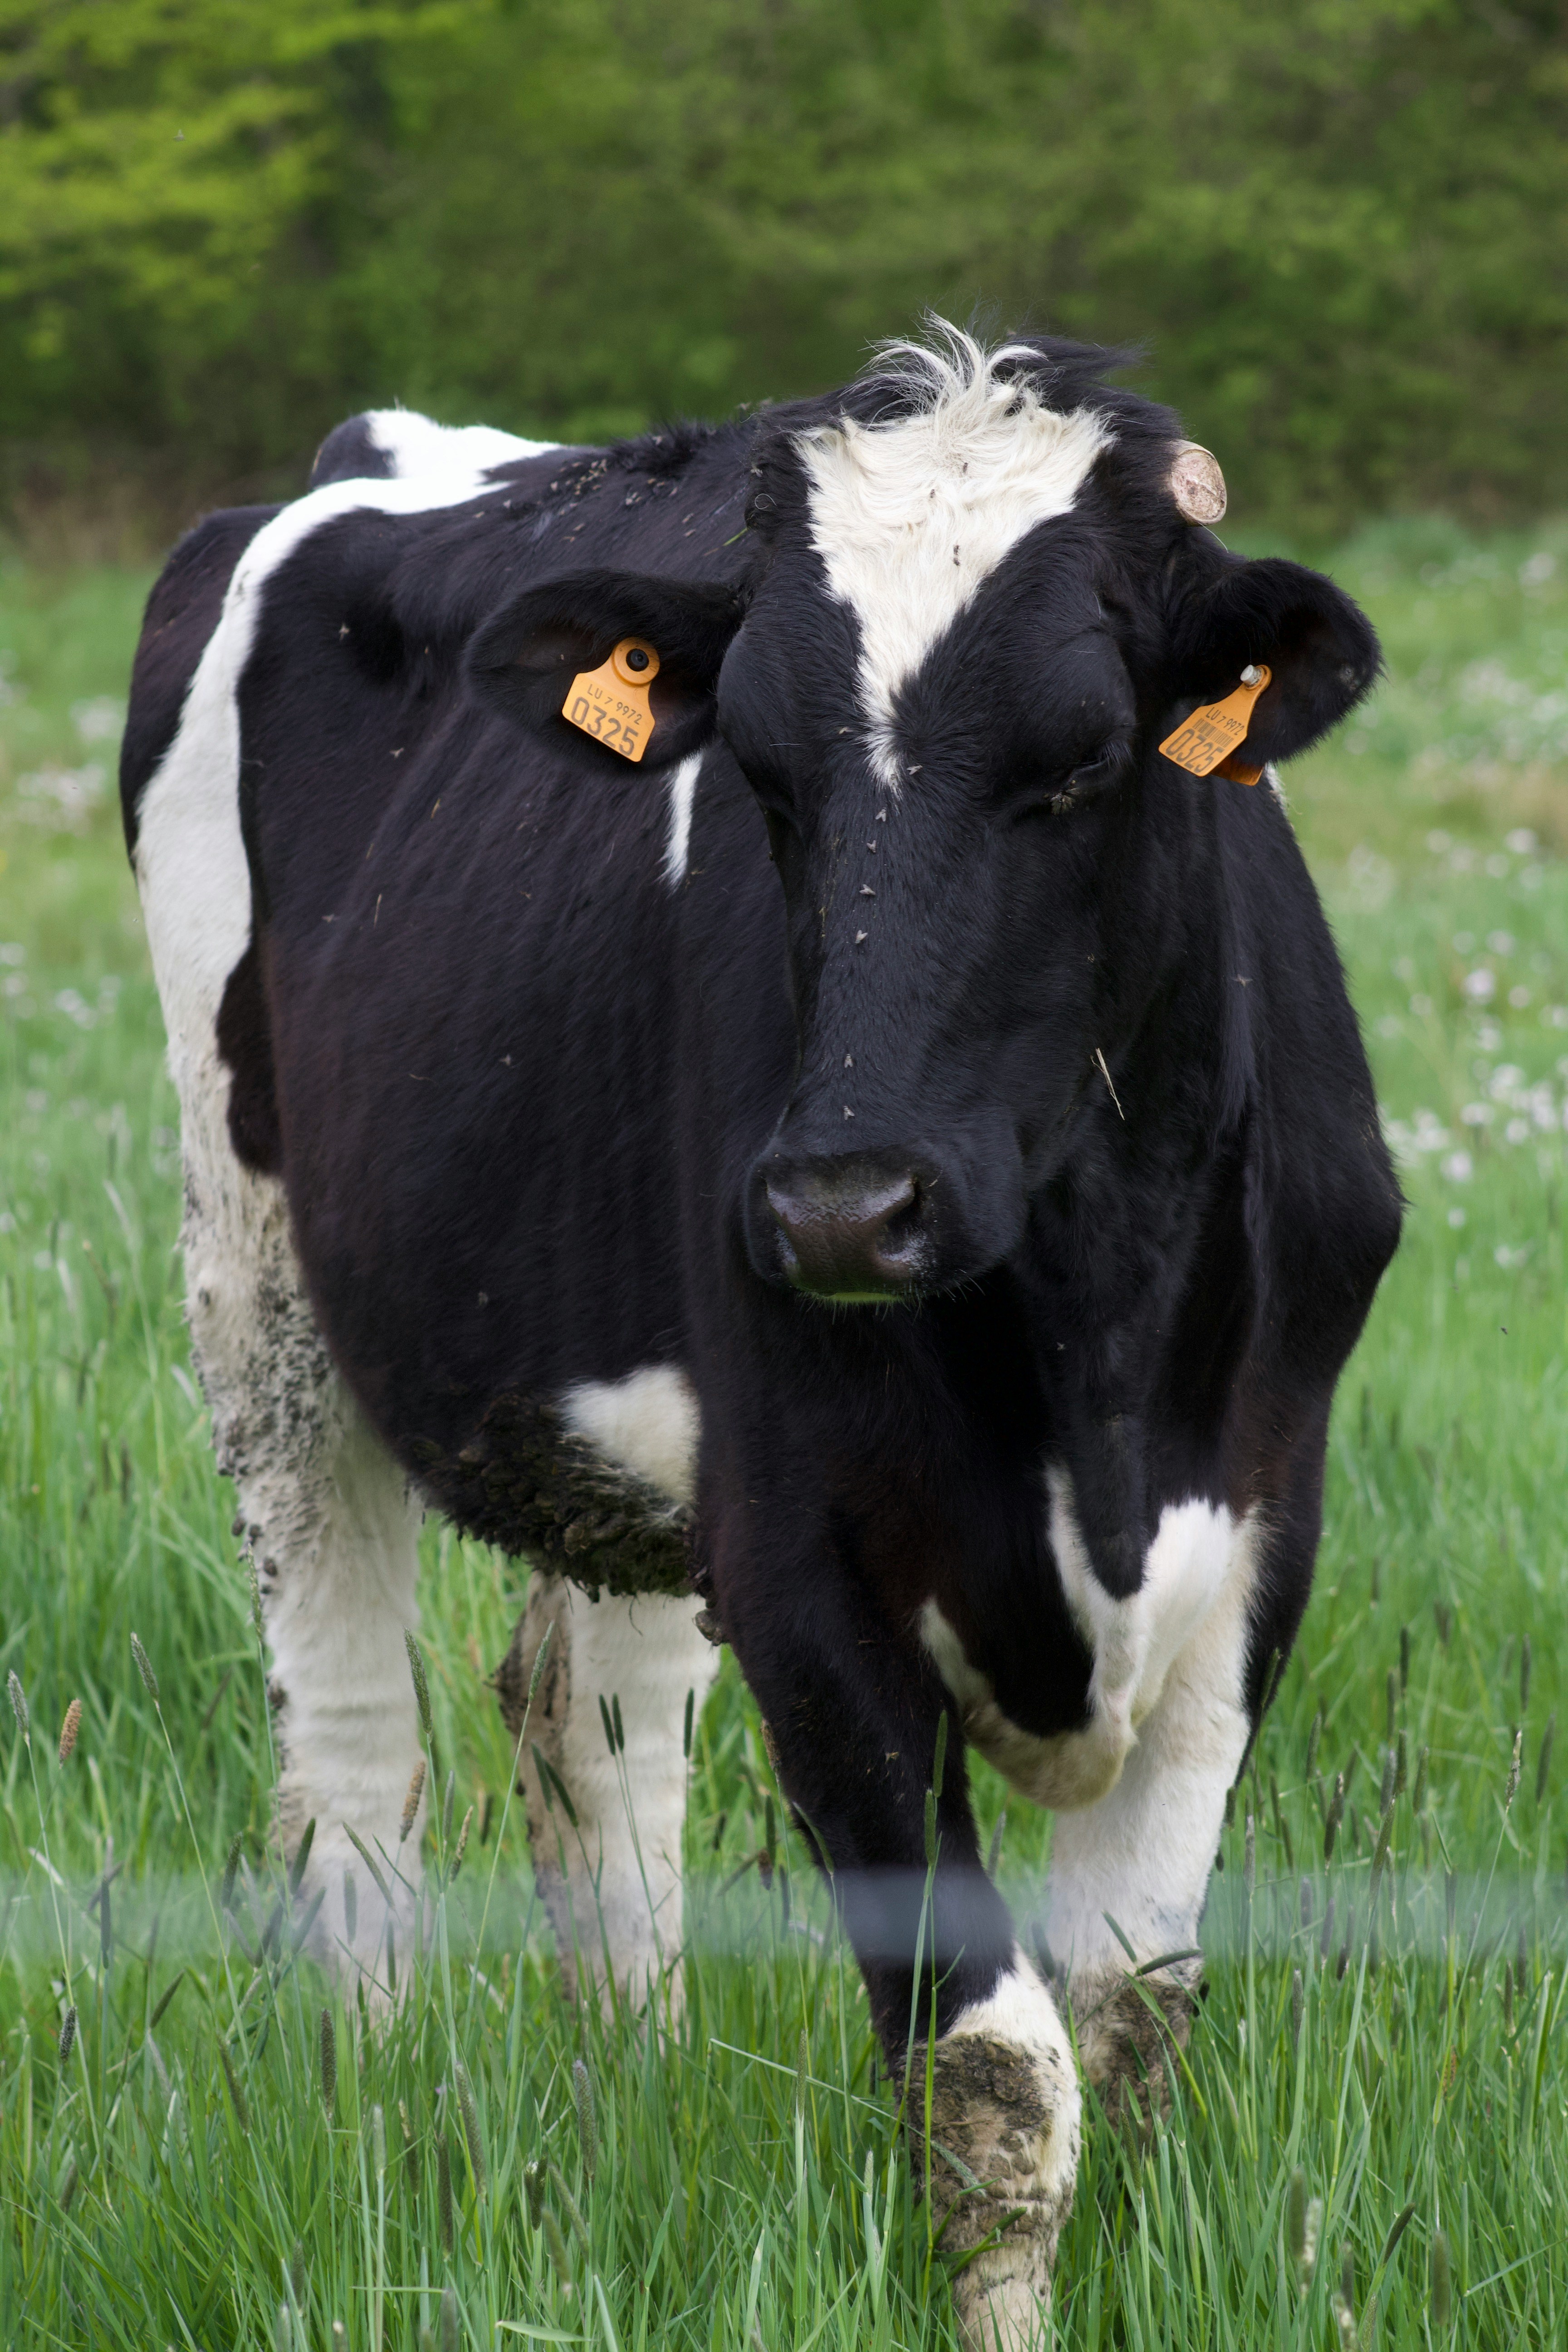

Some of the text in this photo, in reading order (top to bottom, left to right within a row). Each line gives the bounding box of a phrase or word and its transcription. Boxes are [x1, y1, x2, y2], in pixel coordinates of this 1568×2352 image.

[571, 696, 639, 756] 0325
[587, 684, 642, 725] LU 7 9972
[1205, 706, 1221, 720] LU
[1226, 718, 1245, 735] 9972
[1166, 728, 1225, 773] 0325
